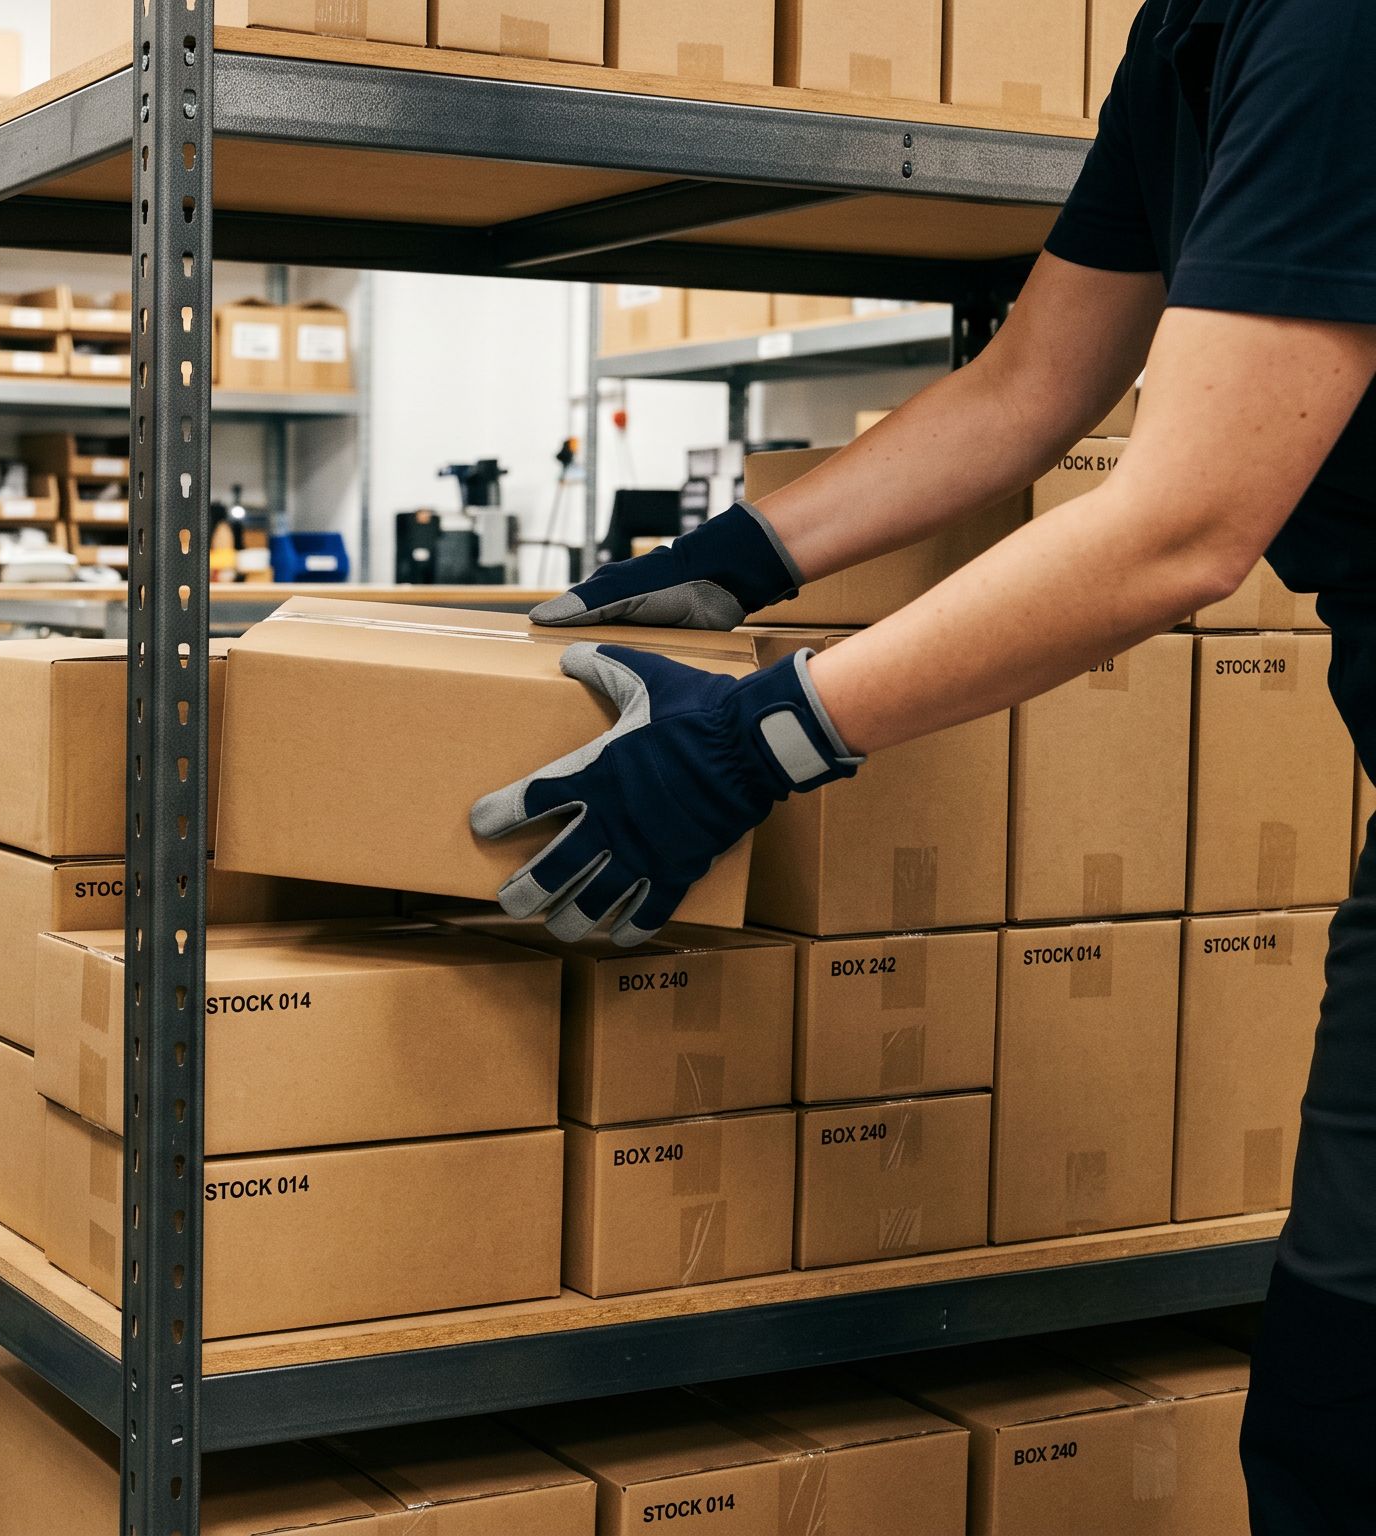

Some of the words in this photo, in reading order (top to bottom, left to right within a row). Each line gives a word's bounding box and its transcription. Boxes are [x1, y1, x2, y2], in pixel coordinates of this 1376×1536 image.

[1216, 659, 1261, 675] STOCK
[75, 880, 124, 898] STOC
[1024, 946, 1074, 966] STOCK
[1077, 944, 1102, 962] 014
[1204, 935, 1251, 954] STOCK
[1253, 934, 1277, 951] 014
[831, 959, 865, 977] BOX
[869, 956, 897, 974] 242
[619, 973, 656, 992] BOX
[660, 971, 689, 989] 240
[206, 993, 274, 1015] STOCK
[279, 991, 312, 1010] 014
[821, 1125, 856, 1145] BOX
[860, 1122, 887, 1141] 240
[613, 1146, 651, 1166] BOX
[654, 1143, 684, 1163] 240
[204, 1177, 273, 1202] STOCK
[277, 1174, 310, 1195] 014
[1014, 1446, 1048, 1466] BOX
[1050, 1441, 1078, 1461] 240
[643, 1498, 702, 1523] STOCK
[706, 1493, 736, 1514] 014
